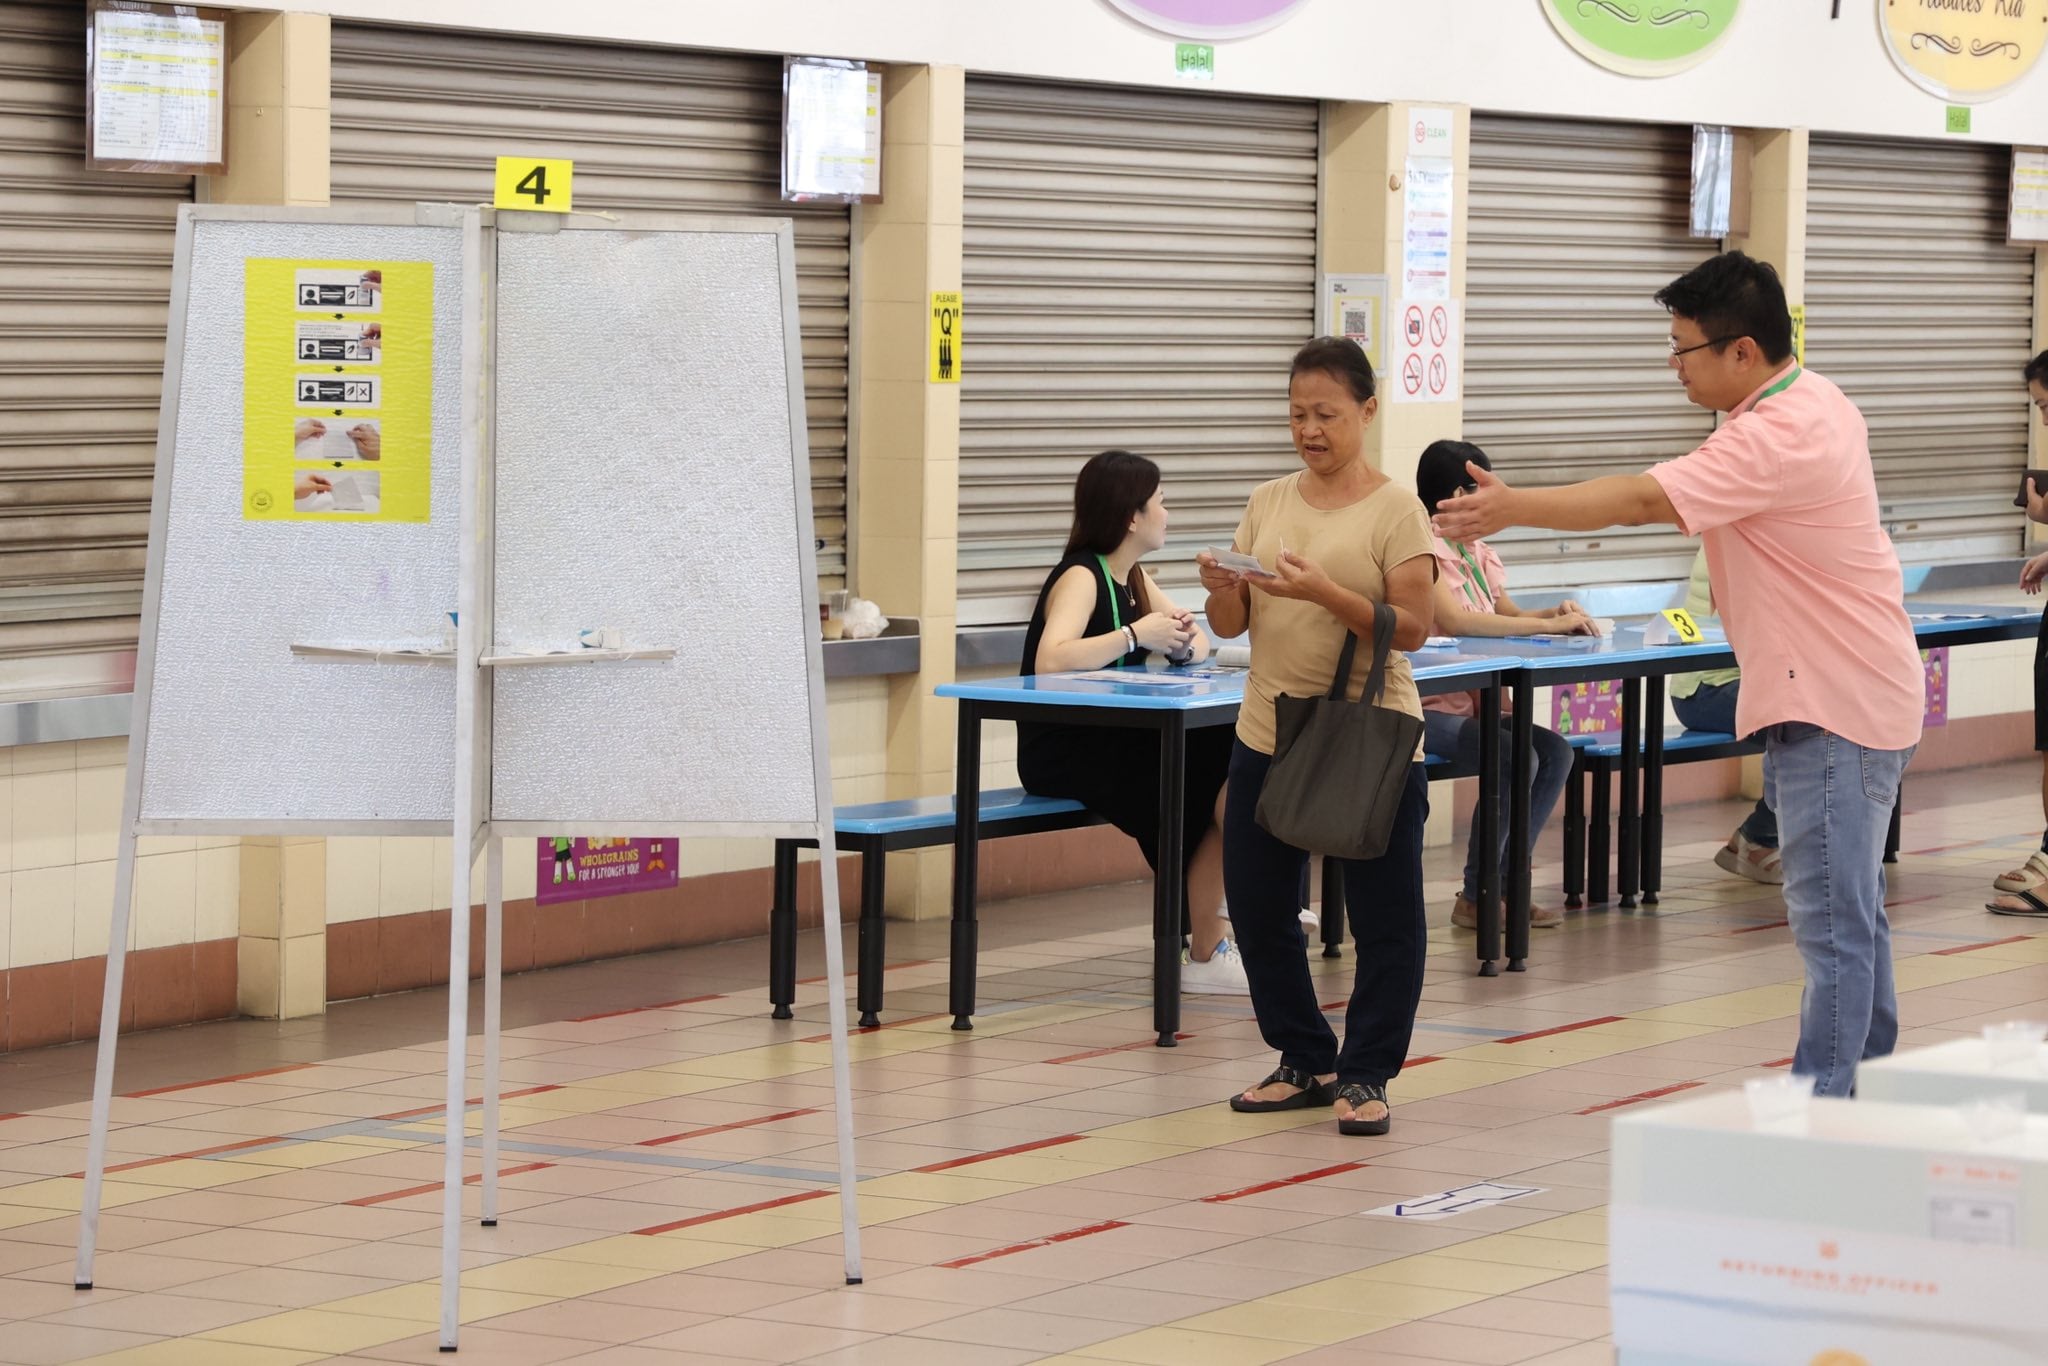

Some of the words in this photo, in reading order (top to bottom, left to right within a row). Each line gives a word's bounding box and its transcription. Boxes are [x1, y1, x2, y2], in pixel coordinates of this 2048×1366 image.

[1427, 128, 1447, 137] CLEAN
[515, 166, 551, 205] 4
[1673, 613, 1695, 637] 3
[580, 849, 638, 866] WHOLEGRAINS
[578, 868, 590, 881] FOR
[591, 868, 596, 880] A
[597, 865, 625, 878] STRONGER
